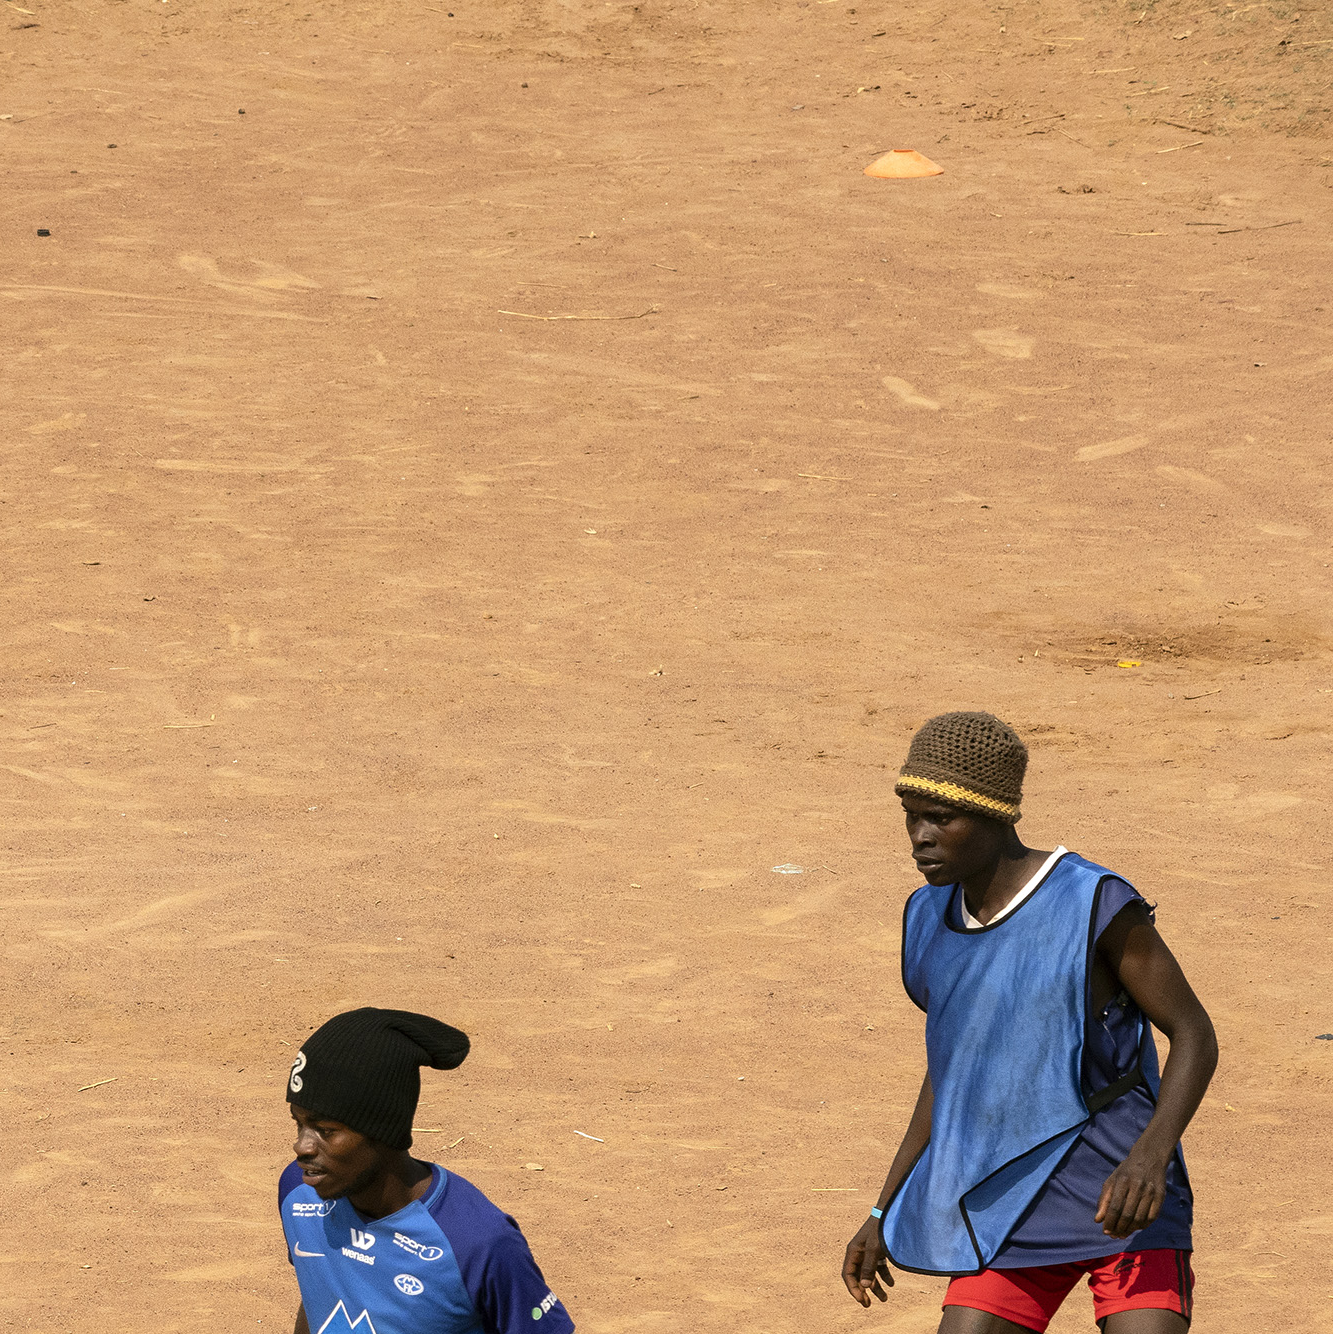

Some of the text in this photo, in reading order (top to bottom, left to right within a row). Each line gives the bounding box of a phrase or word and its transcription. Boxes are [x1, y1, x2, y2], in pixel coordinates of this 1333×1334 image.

[292, 1203, 324, 1212] sport
[394, 1232, 428, 1253] sport
[341, 1246, 376, 1266] wenaas
